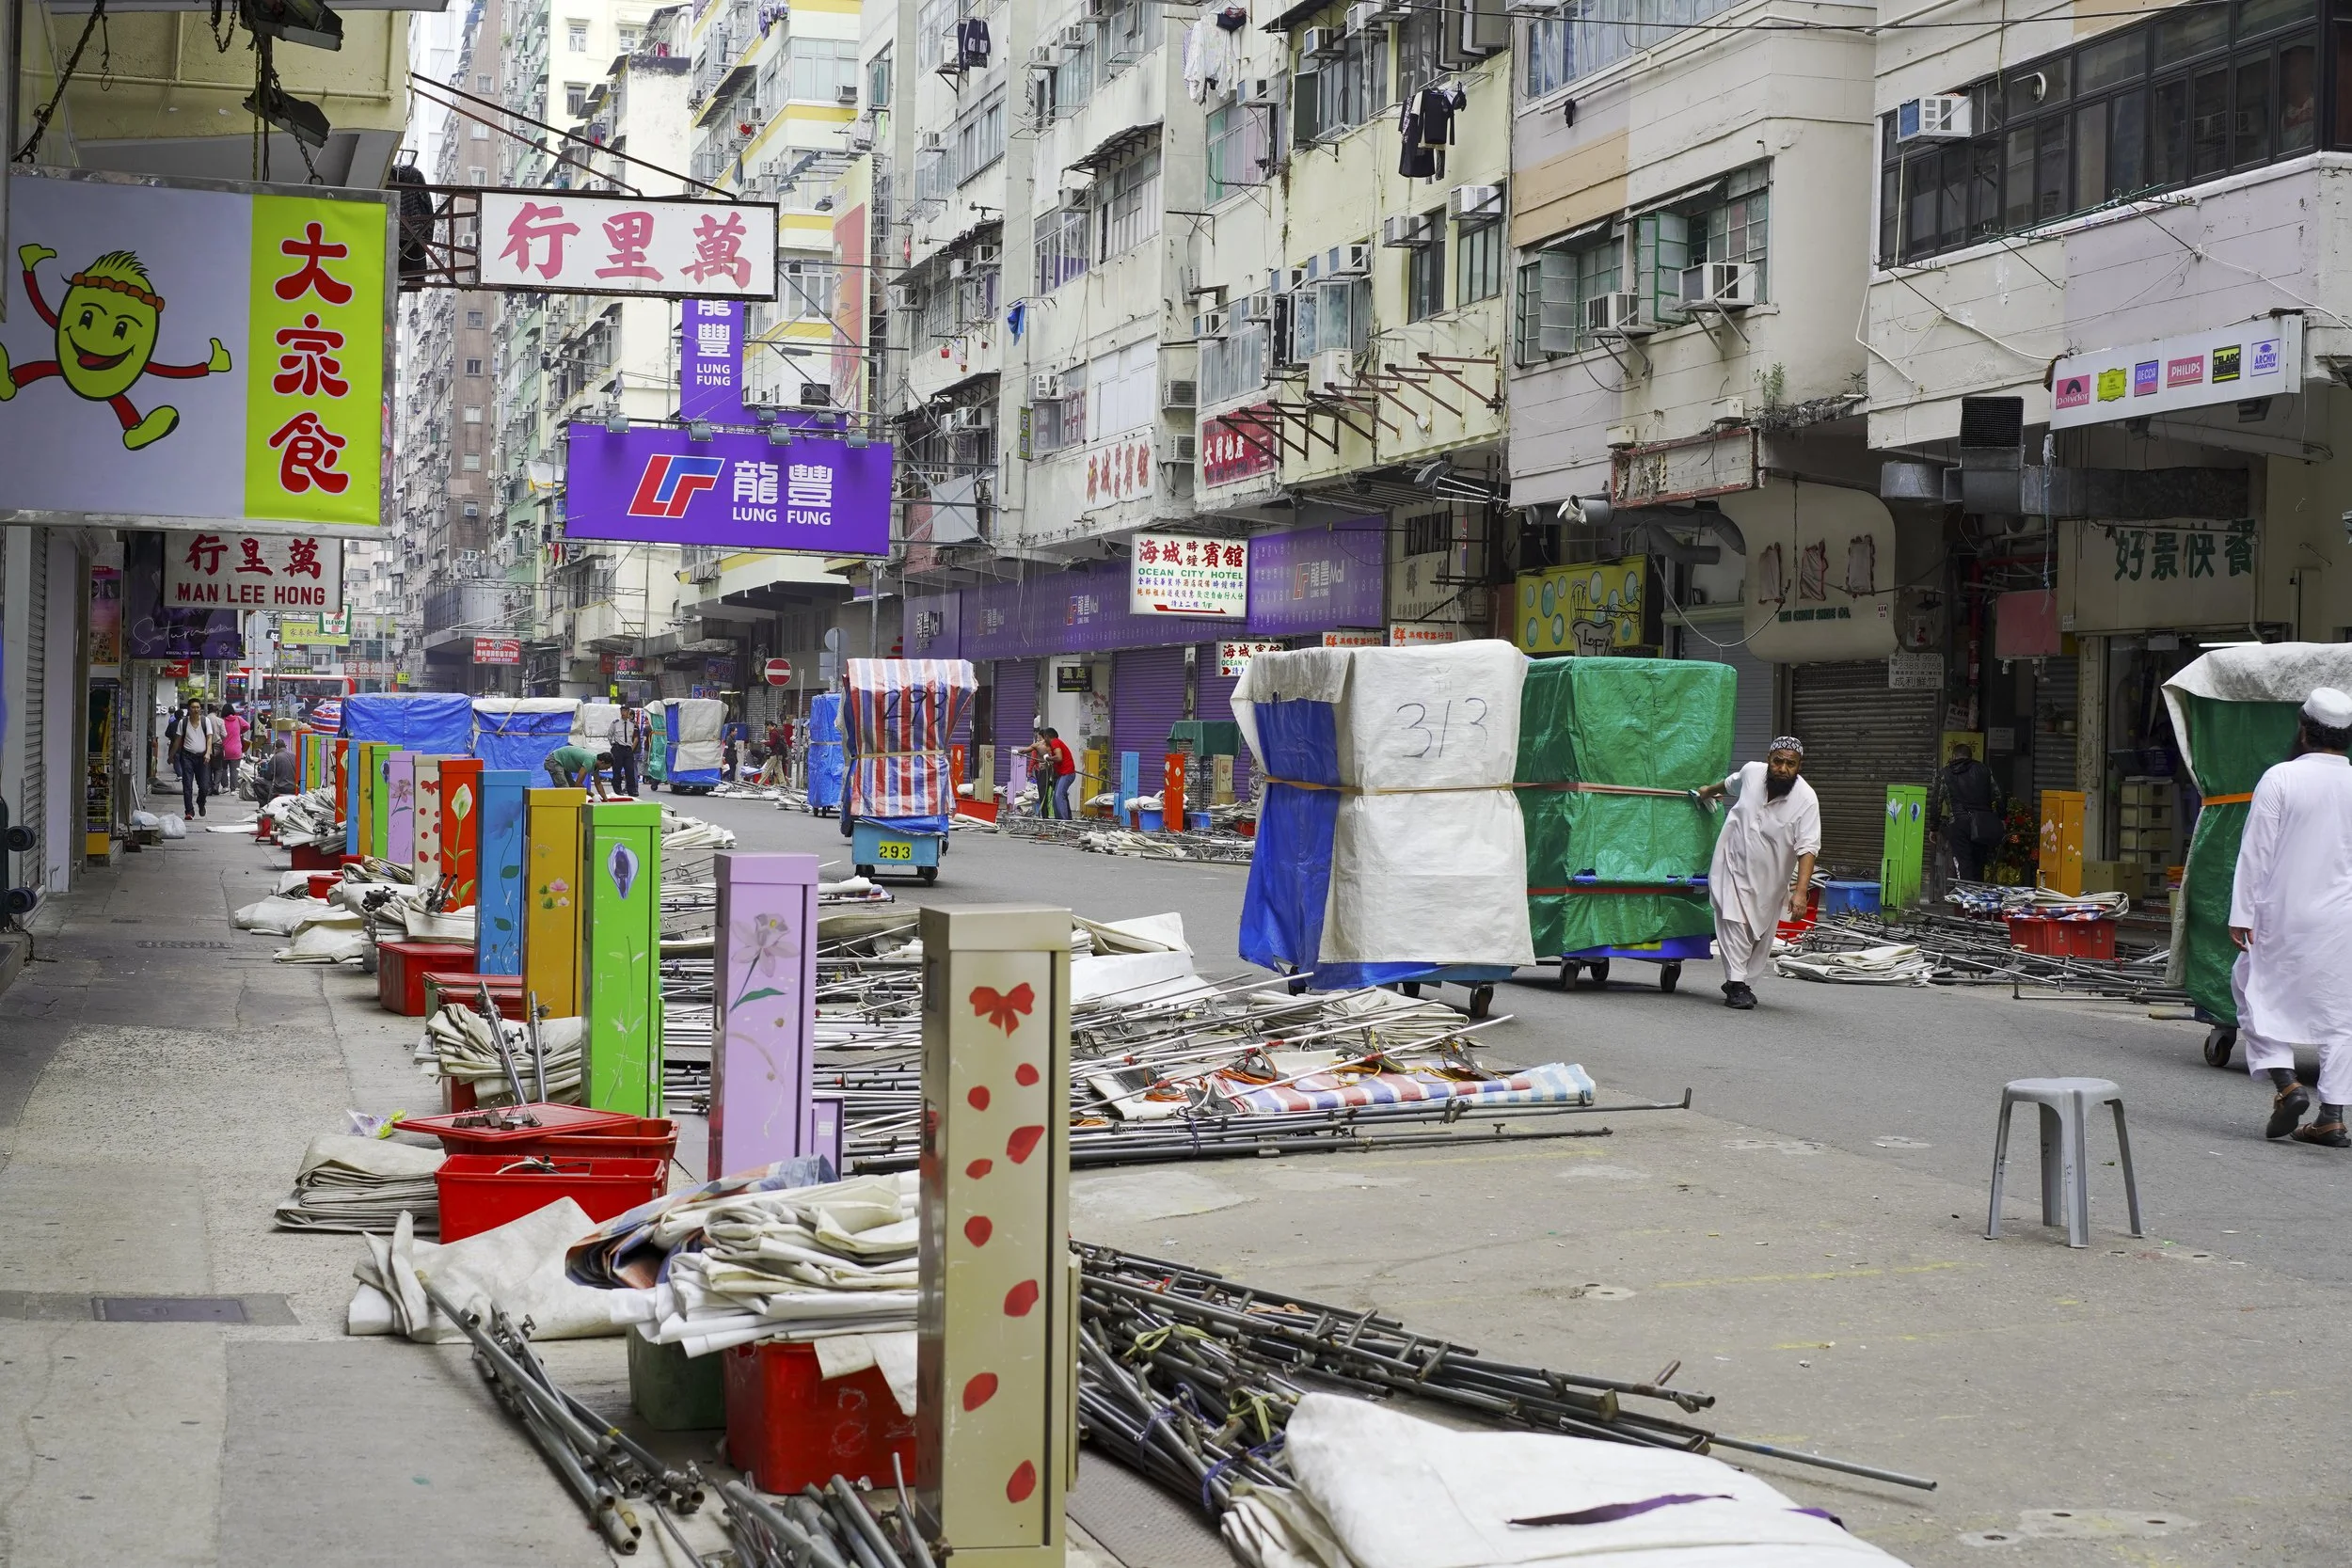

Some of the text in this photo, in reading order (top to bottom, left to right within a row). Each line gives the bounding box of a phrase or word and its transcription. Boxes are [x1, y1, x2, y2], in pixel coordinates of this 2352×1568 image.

[268, 221, 354, 495] 大家食
[696, 363, 731, 374] LUNG
[2171, 362, 2200, 377] PHILIPS
[696, 375, 731, 387] FUNG
[733, 460, 834, 509] 龍豐
[732, 507, 831, 526] LUNG FUNG
[2115, 519, 2254, 581] 好景快餐
[1138, 567, 1243, 579] OCEAN CITY HOTEL
[177, 582, 326, 607] MAN LEE HONG
[882, 689, 948, 732] 293
[1396, 697, 1488, 758] 313
[879, 845, 911, 860] 293
